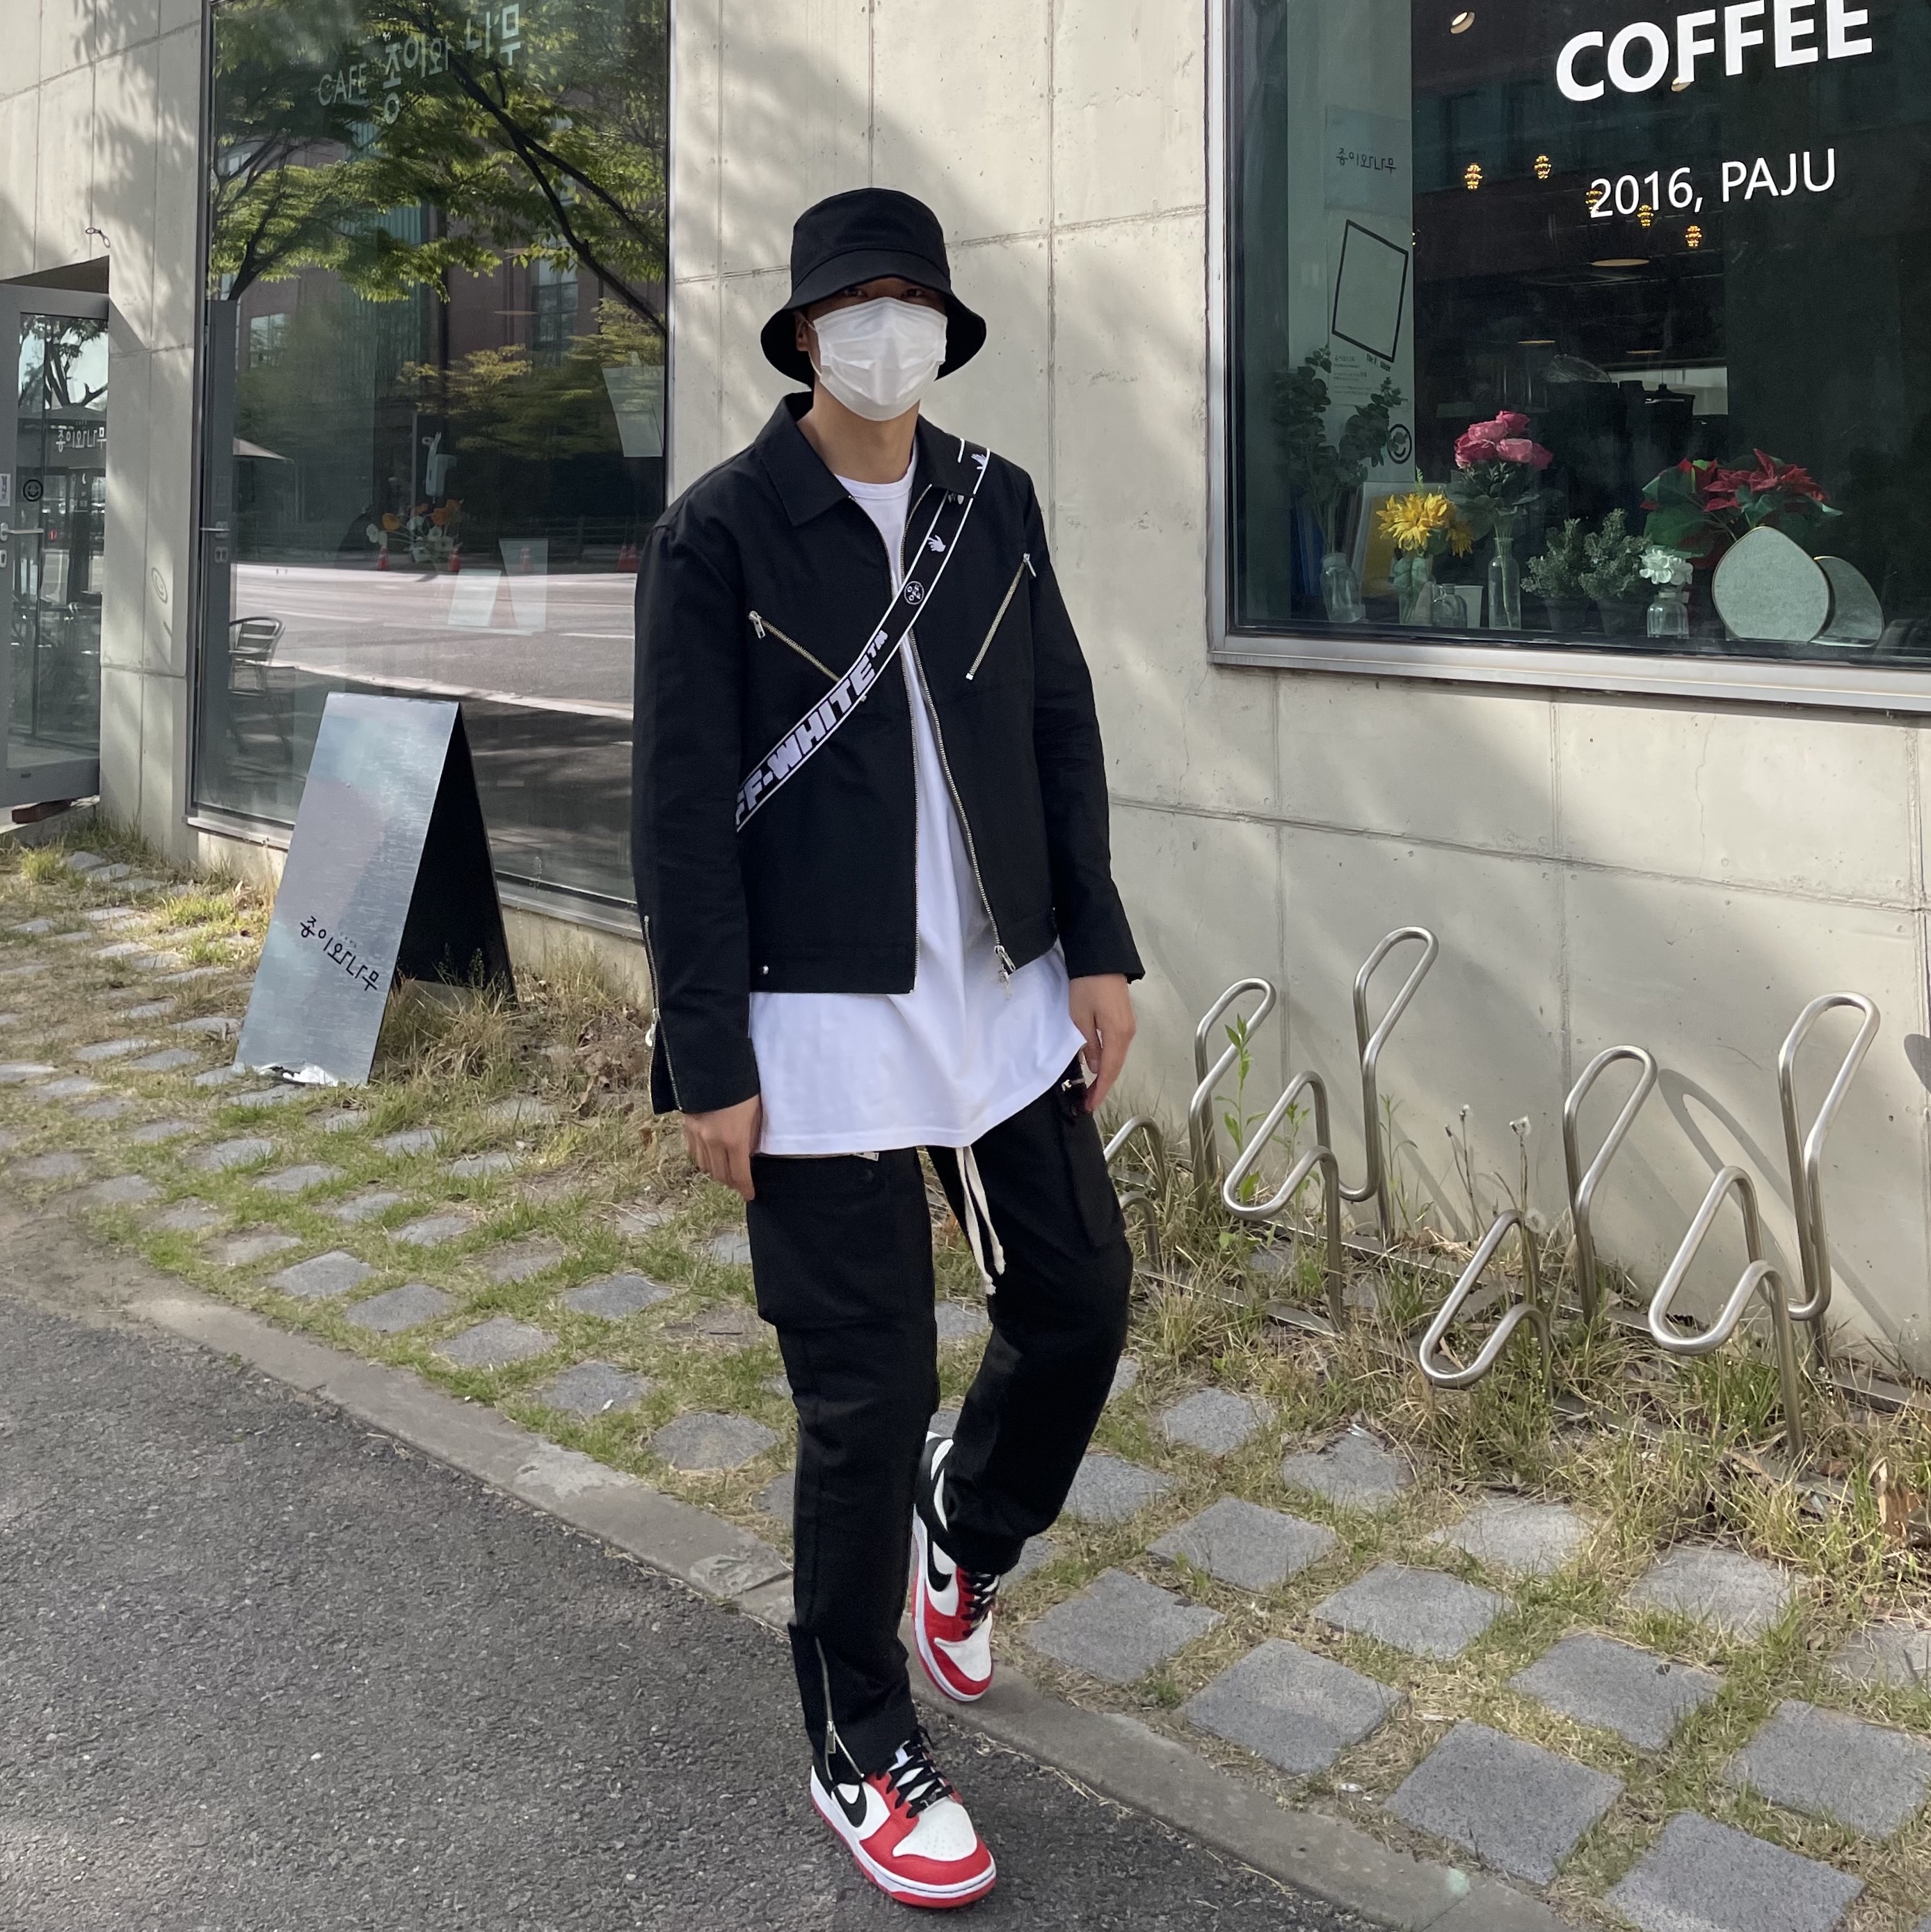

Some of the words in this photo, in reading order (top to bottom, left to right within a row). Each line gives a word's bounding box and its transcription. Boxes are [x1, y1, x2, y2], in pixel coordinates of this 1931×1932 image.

[319, 62, 367, 106] CAFE
[1555, 0, 1873, 102] COFFEE
[1589, 167, 1703, 218] 2016,
[1721, 147, 1836, 202] PAJU
[300, 916, 380, 991] 종이와나무
